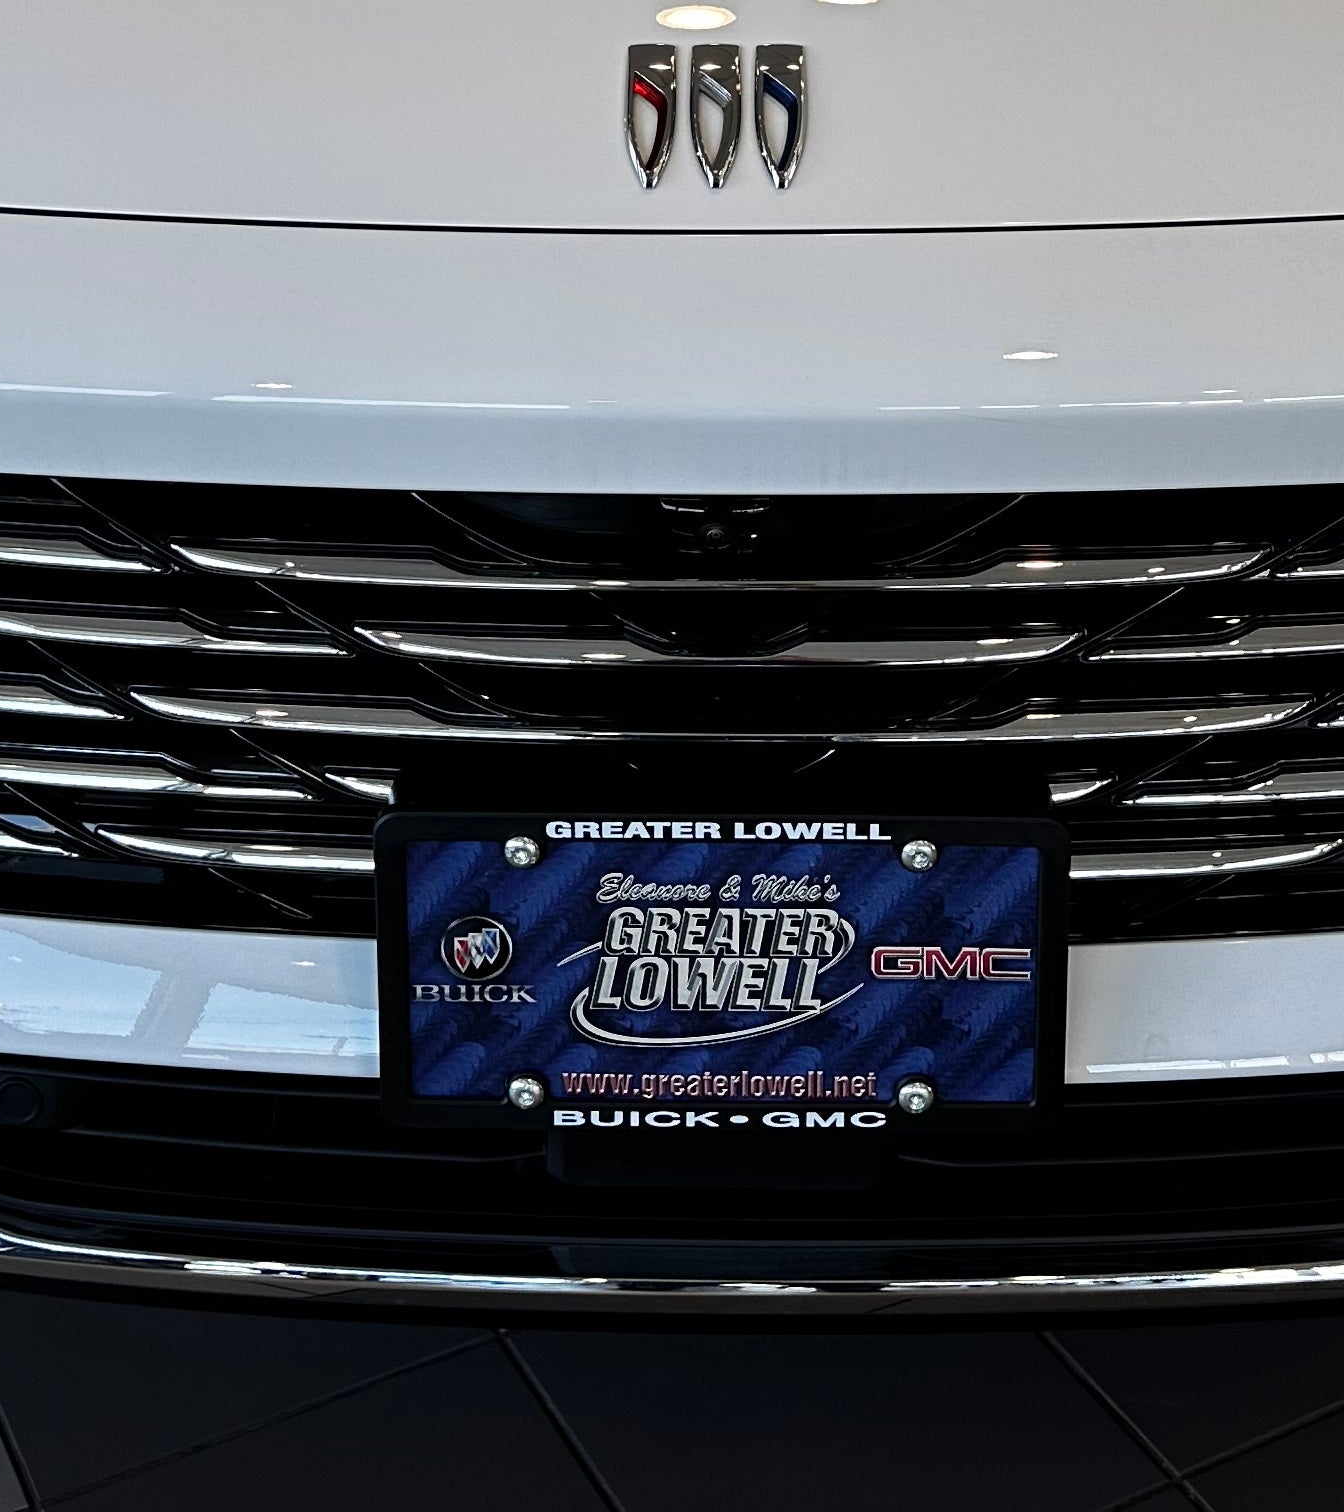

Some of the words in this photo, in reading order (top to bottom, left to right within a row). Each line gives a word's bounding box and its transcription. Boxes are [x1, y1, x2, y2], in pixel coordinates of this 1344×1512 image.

[545, 820, 722, 841] GREATER
[733, 822, 892, 842] LOWELL
[596, 872, 712, 904] Eleanore
[719, 876, 741, 903] &
[751, 872, 841, 904] Mike's
[602, 906, 840, 957] GREATER
[869, 946, 1033, 982] GMC
[412, 983, 538, 1005] BUICK
[589, 954, 823, 1014] LOWELL
[561, 1069, 879, 1100] www.greaterlowell.net
[552, 1110, 720, 1129] BUICK
[761, 1110, 888, 1129] GMC
